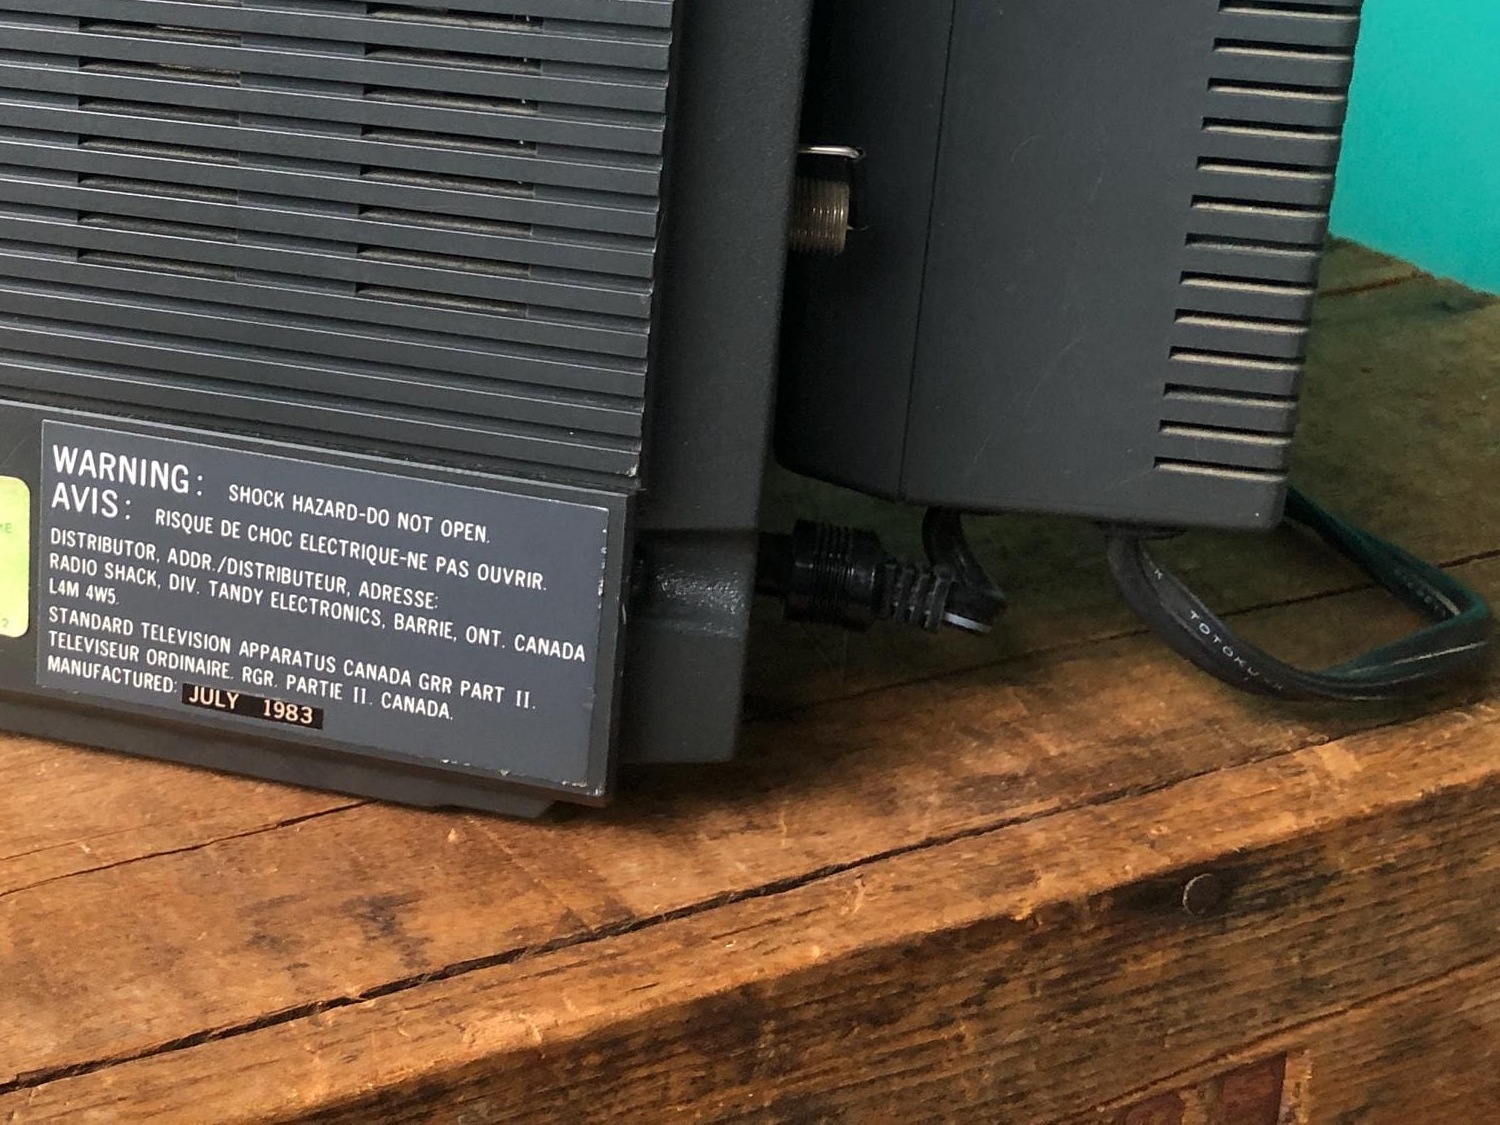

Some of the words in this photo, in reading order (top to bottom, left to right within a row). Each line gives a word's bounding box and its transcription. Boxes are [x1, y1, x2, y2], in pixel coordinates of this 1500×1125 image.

[51, 482, 132, 520] AVIS:
[156, 508, 214, 535] RISQUE
[221, 520, 240, 539] DE
[248, 525, 293, 547] CHOC
[300, 532, 428, 571] ELECTRIQUE-NE
[436, 556, 469, 577] PAS
[477, 564, 547, 591] OUVRIR.
[52, 444, 203, 496] WARNING:
[229, 484, 285, 509] SHOCK
[292, 494, 389, 525] HAZARD-DO
[397, 512, 433, 533] NOT
[441, 520, 491, 544] OPEN.
[50, 528, 159, 563] DISTRIBUTOR,
[167, 548, 350, 596] ADDR./DISTRIBUTEUR,
[358, 581, 438, 609] ADRESSE:
[50, 578, 79, 598] L4M
[86, 584, 120, 605] 4W5.
[50, 553, 97, 576] RADIO
[104, 562, 161, 590] SHACK,
[169, 574, 200, 595] DIV.
[209, 580, 263, 605] TANDY
[270, 591, 386, 629] ELECTRONICS,
[394, 614, 457, 642] BARRIE,
[466, 626, 505, 648] ONT.
[514, 635, 585, 662] CANADA
[48, 656, 177, 693] MANUFACTURED:
[189, 686, 239, 709] JULY
[262, 699, 313, 724] 1983
[49, 606, 133, 636] STANDARD
[141, 622, 231, 654] TELEVISION
[238, 640, 336, 673] APPARATUS
[344, 659, 411, 687] CANADA
[419, 673, 452, 694] GRR
[460, 680, 505, 703] PART
[515, 690, 536, 709] II.
[49, 631, 140, 662] TELEVISEUR
[146, 649, 234, 679] ORDINAIRE.
[242, 666, 277, 687] RGR.
[286, 674, 343, 699] PARTIE
[353, 688, 372, 706] II.
[381, 692, 453, 720] CANADA.
